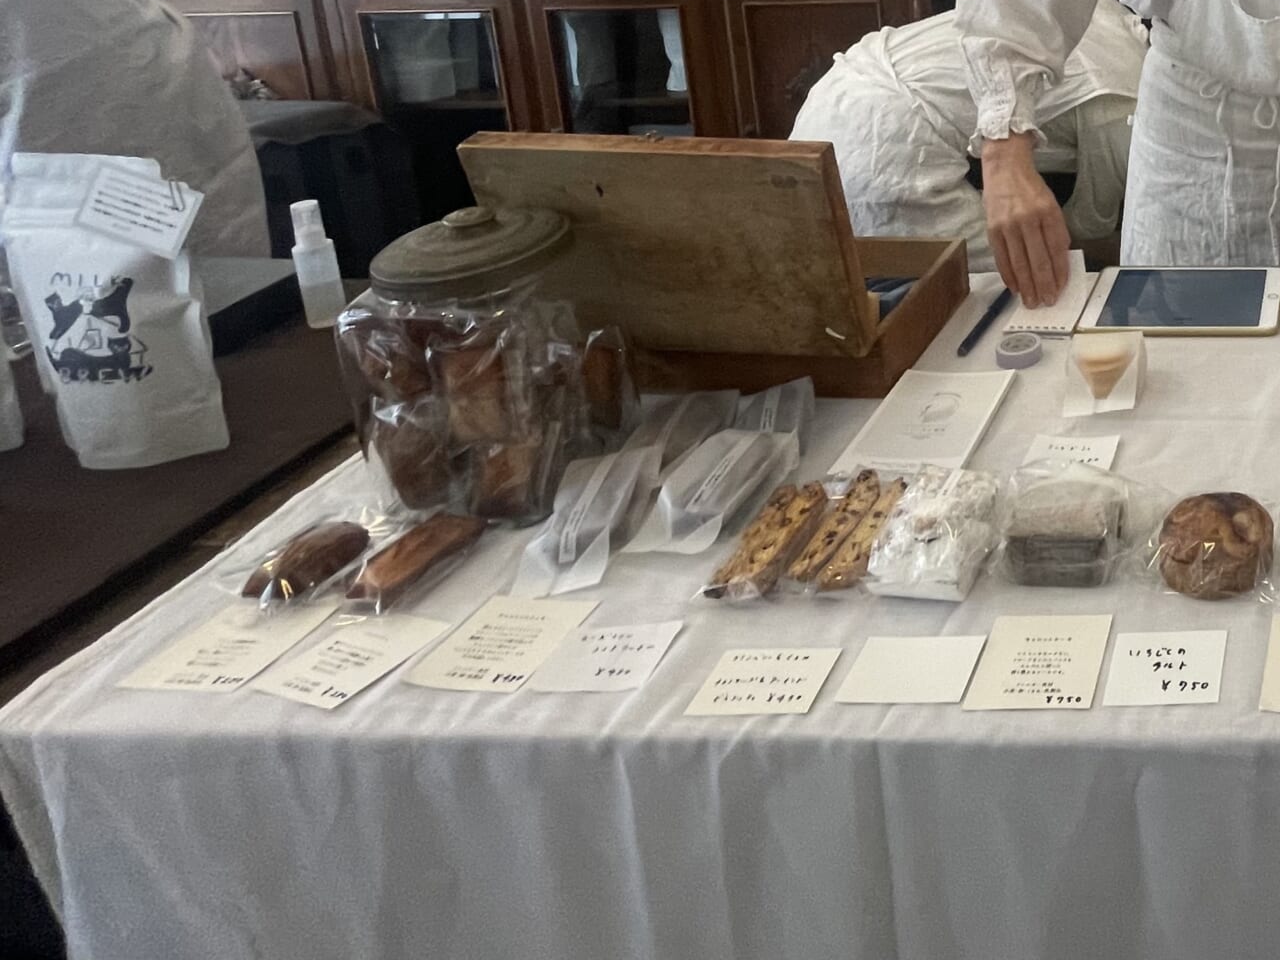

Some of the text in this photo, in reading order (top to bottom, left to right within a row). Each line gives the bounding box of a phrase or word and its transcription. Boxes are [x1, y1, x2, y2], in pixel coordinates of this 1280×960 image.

[50, 271, 122, 289] MILK
[59, 366, 153, 385] BREW
[1161, 679, 1209, 692] ¥750
